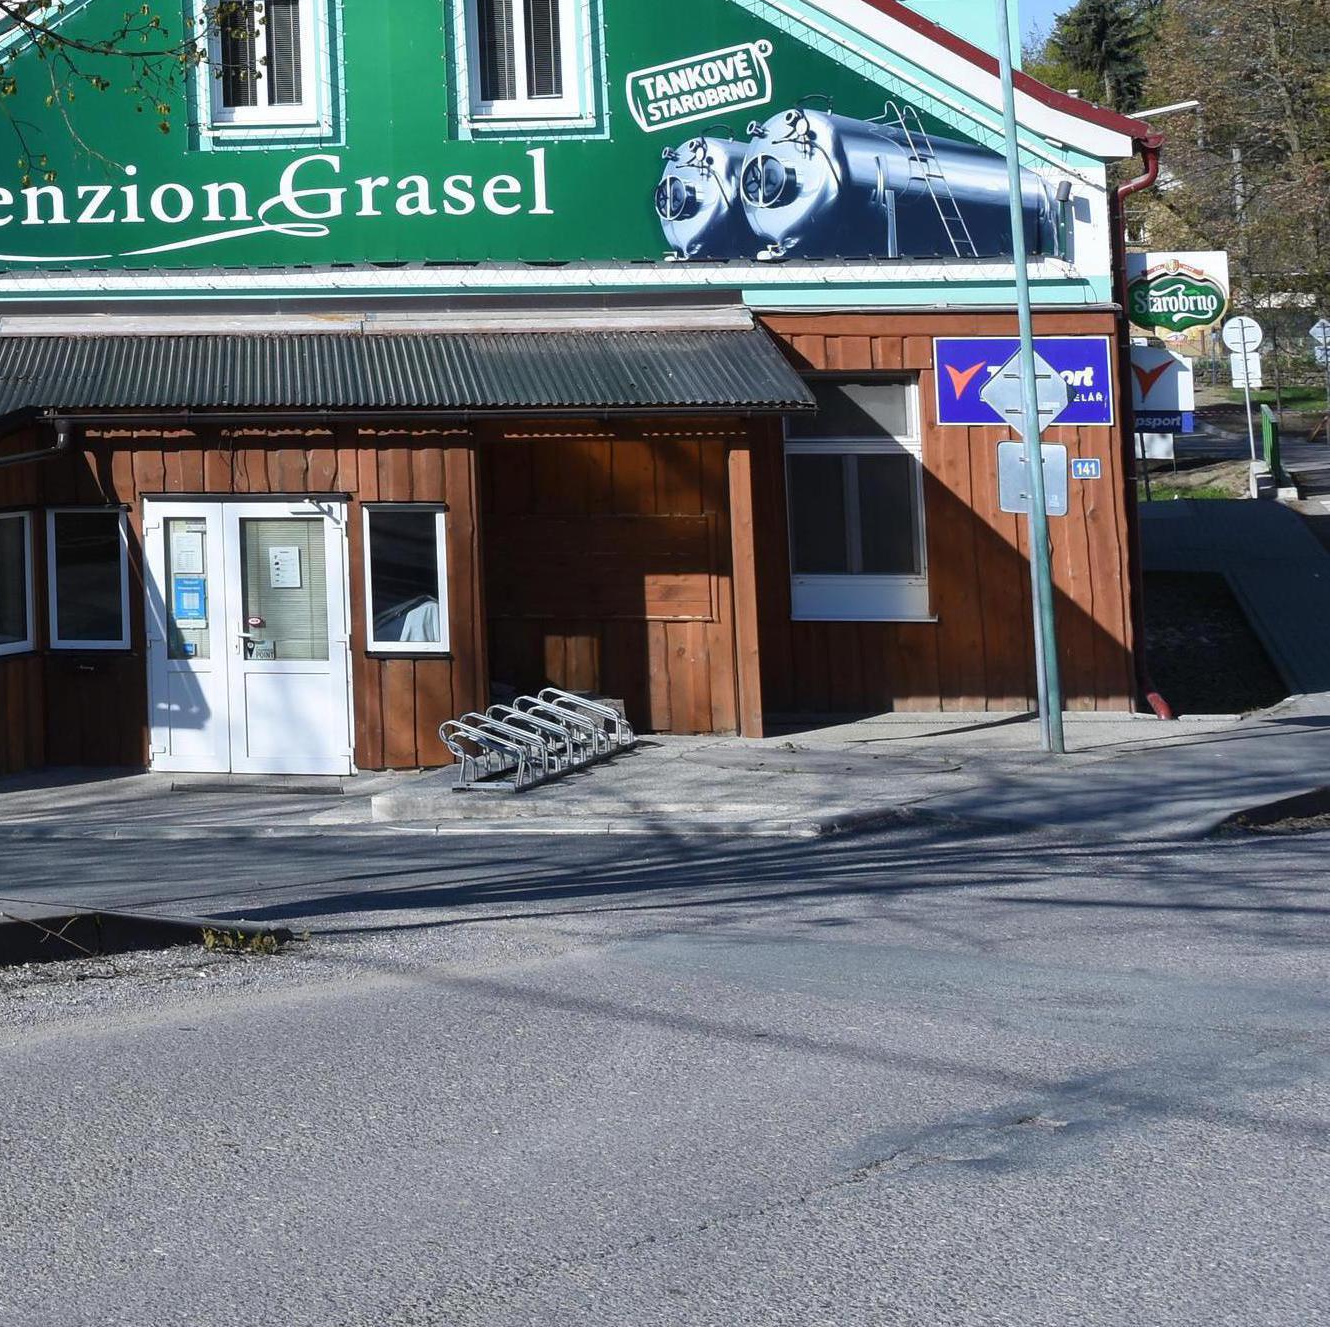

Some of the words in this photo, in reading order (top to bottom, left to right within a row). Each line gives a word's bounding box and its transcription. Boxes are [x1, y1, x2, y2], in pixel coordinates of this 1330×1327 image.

[639, 51, 753, 101] TANKOVÉ
[647, 78, 758, 121] STAROBRNO
[258, 147, 554, 236] Grasel
[1134, 284, 1218, 323] Starobrno
[1076, 463, 1096, 476] 141
